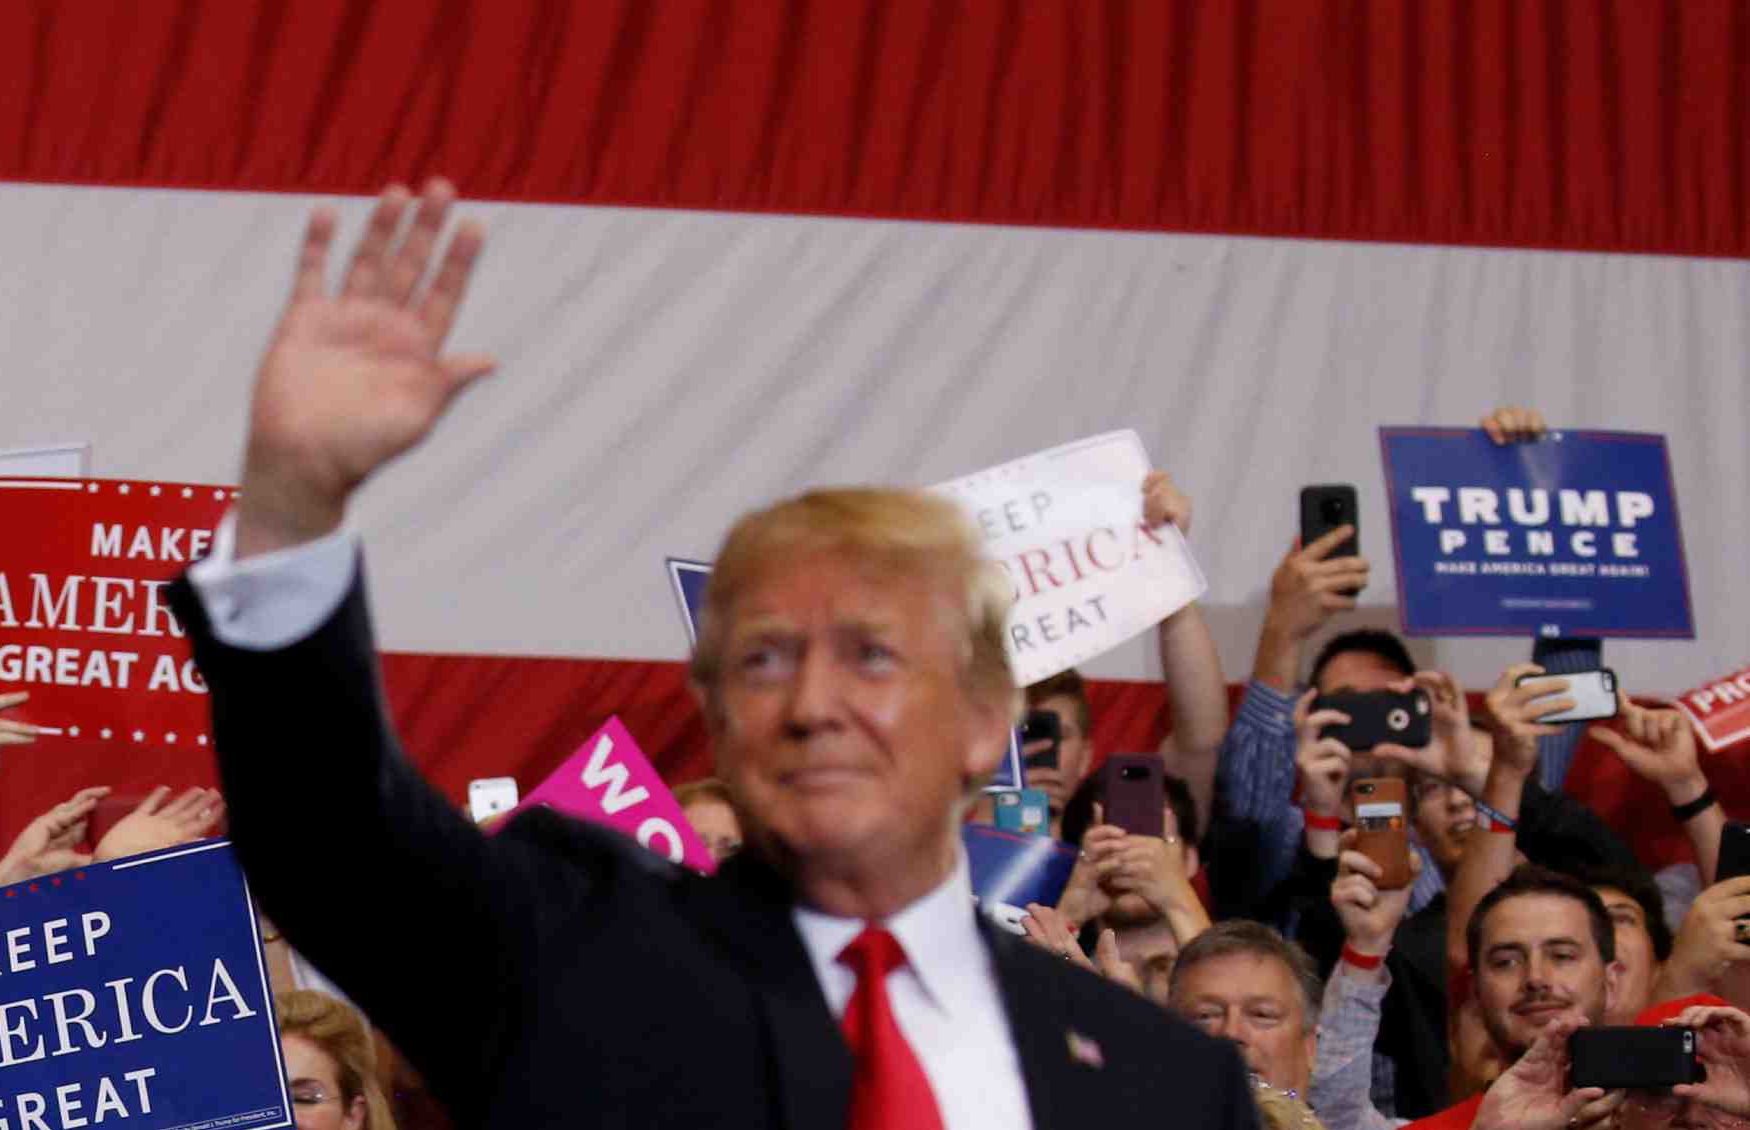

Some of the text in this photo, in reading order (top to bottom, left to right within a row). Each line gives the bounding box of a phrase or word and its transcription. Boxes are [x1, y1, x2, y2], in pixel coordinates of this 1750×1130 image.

[976, 490, 1053, 541] EEP
[1411, 485, 1656, 528] TRUMP
[90, 522, 213, 562] MAKE
[1439, 529, 1640, 558] PENCE
[1480, 562, 1547, 576] AMERICA
[1010, 594, 1110, 653] REAT
